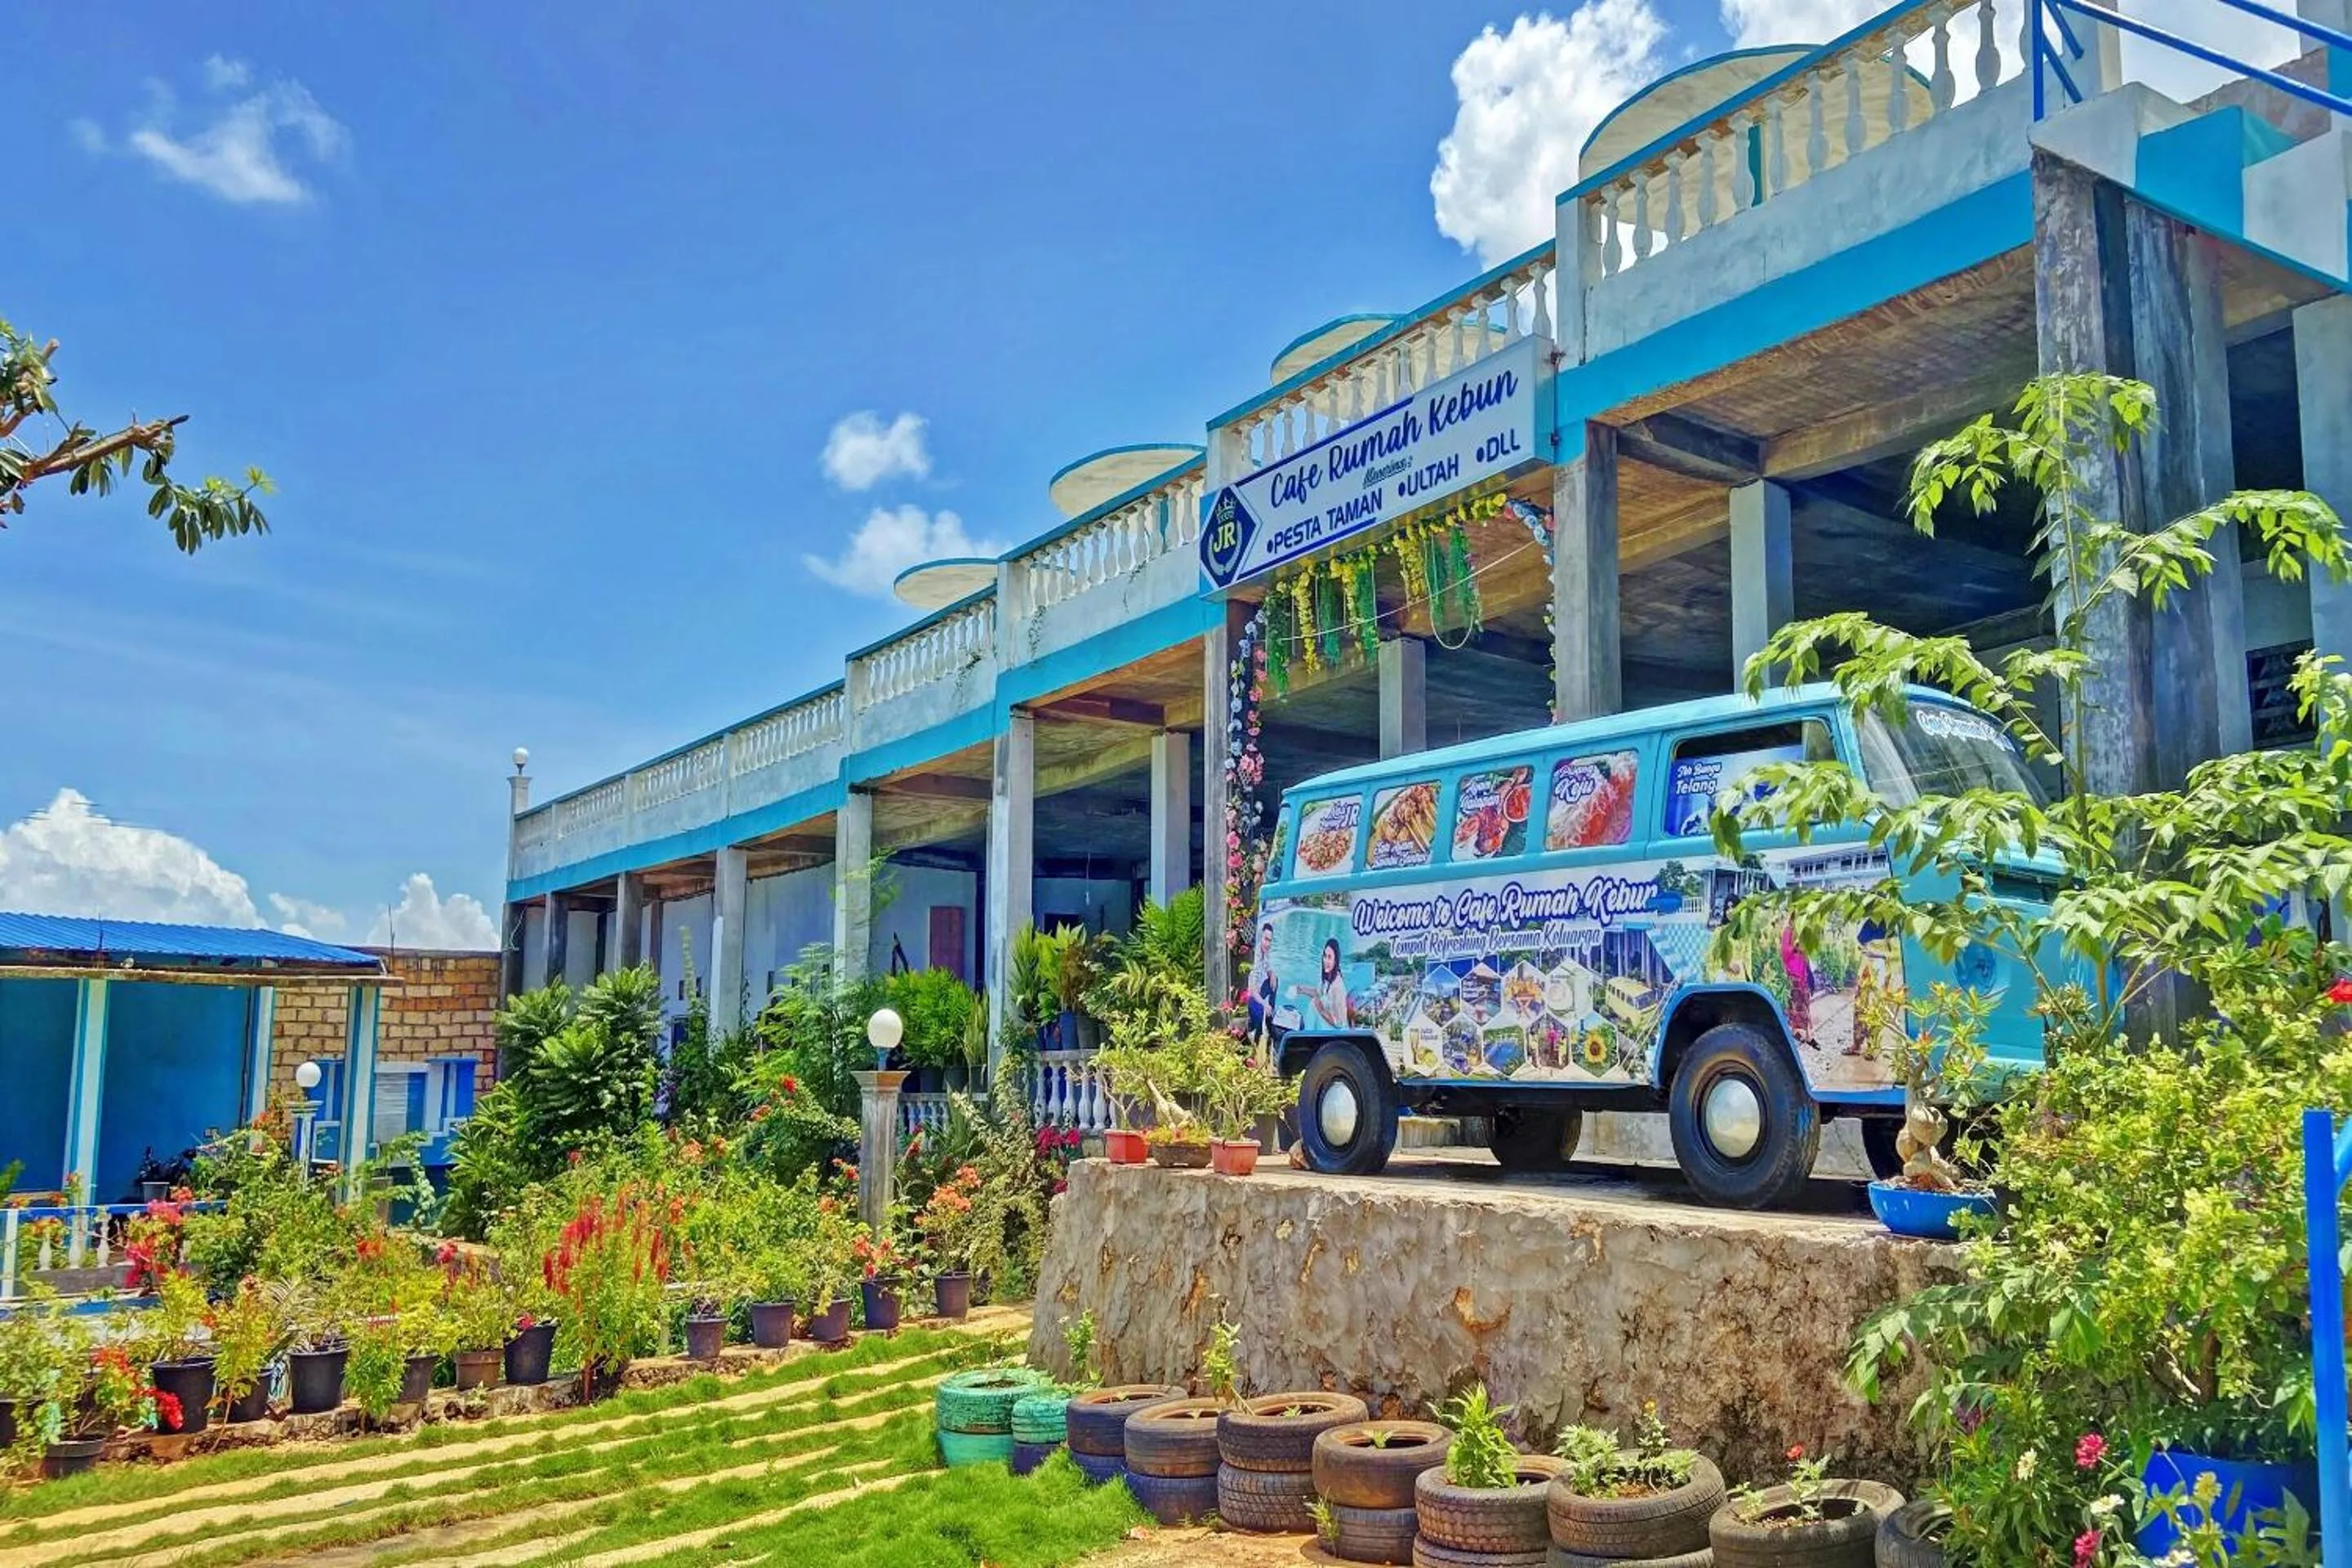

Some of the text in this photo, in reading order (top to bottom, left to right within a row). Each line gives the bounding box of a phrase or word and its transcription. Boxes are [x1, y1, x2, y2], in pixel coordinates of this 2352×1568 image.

[1272, 370, 1517, 508] Cafe Rumah Kebun
[1275, 429, 1520, 554] PESTA TAMAN ULTAH DLL
[1214, 522, 1236, 553] JR
[1555, 777, 1595, 804] Keju
[1676, 777, 1717, 795] Telang
[1342, 803, 1361, 827] JR
[1353, 898, 1432, 935] Welcome
[1433, 895, 1452, 928] to
[1454, 887, 1497, 932] Cafe
[1500, 880, 1580, 929] Rumah
[1389, 921, 1604, 963] Tempat Refreshing Bersama Keluarga
